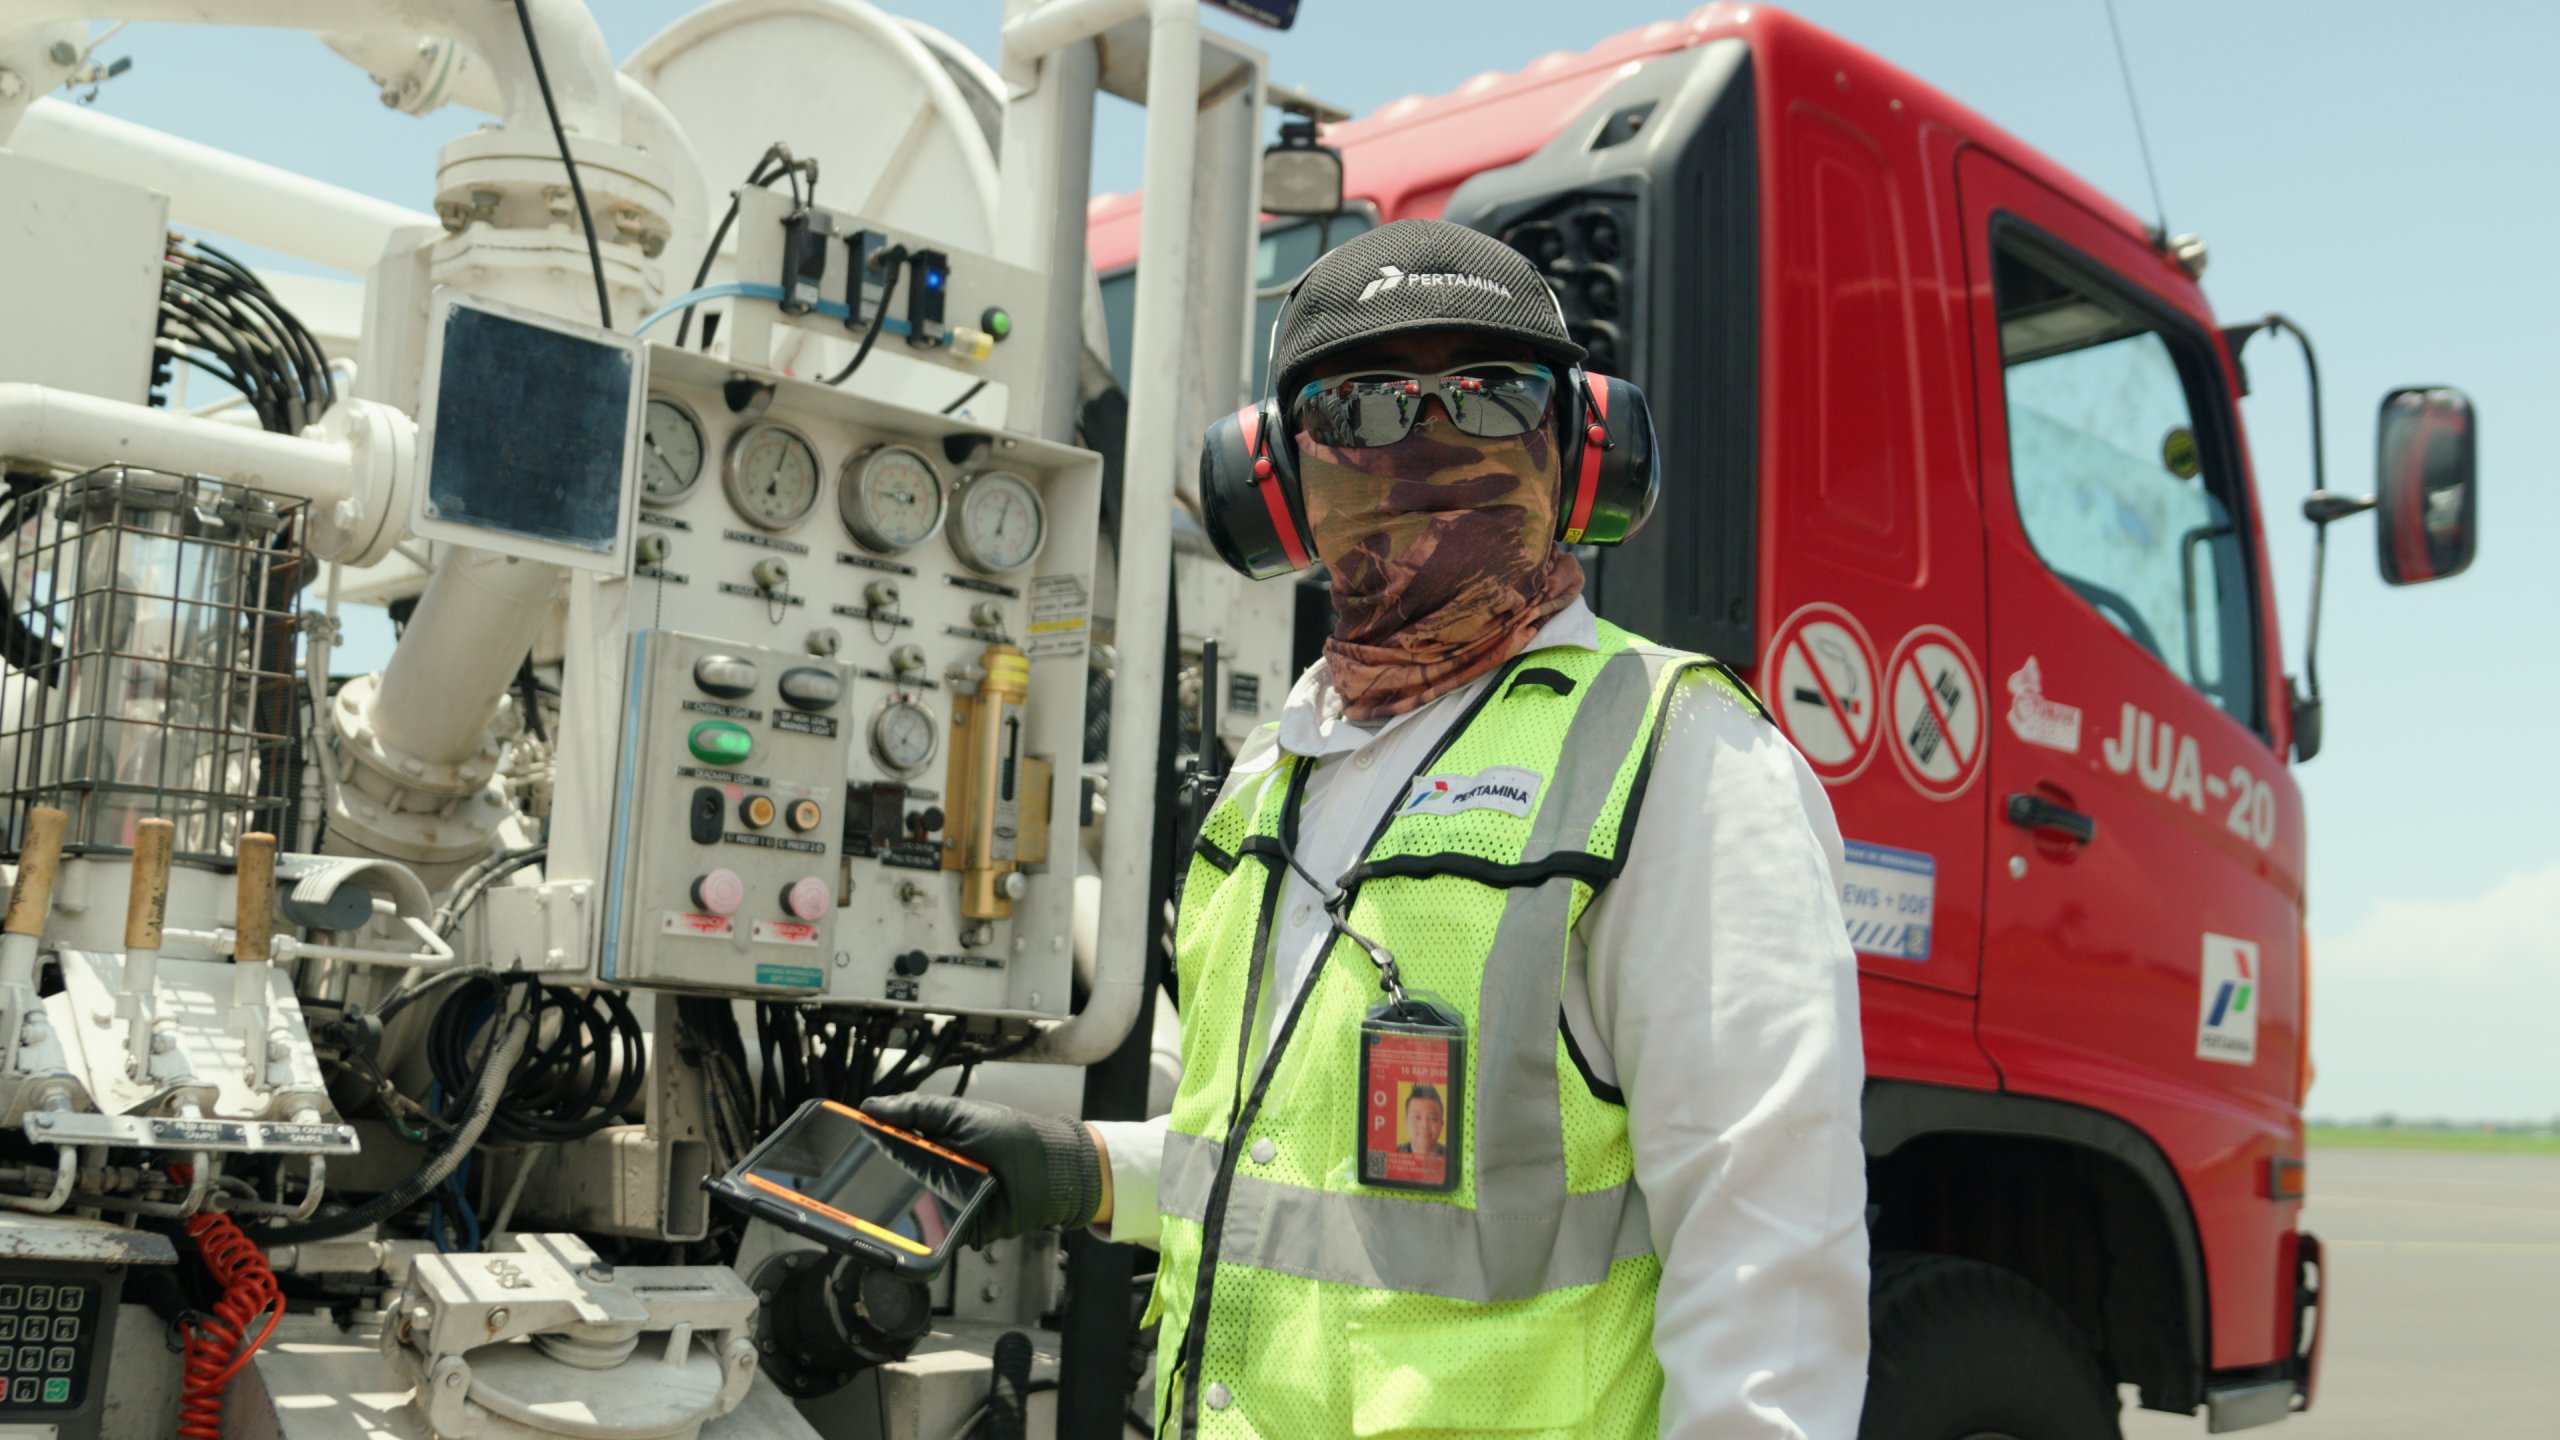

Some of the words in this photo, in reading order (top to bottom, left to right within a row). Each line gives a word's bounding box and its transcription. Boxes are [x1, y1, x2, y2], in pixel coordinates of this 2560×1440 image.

[1408, 273, 1513, 299] PERTAMINA
[694, 701, 728, 716] OVERFILL
[728, 706, 751, 719] LIGHT
[780, 721, 810, 733] WARNING
[811, 725, 831, 736] LIGHT
[793, 713, 810, 724] HIGH
[811, 716, 829, 727] LEVEL
[694, 768, 732, 783] DEADMAN
[733, 773, 755, 785] LIGHT
[2103, 702, 2275, 849] JUA-20
[1452, 784, 1528, 804] PERTAMINA
[736, 833, 760, 847] PRESET
[1842, 883, 1879, 908] EWS
[1411, 1066, 1428, 1077] SEP
[1373, 1090, 1387, 1107] O
[1374, 1115, 1386, 1131] P
